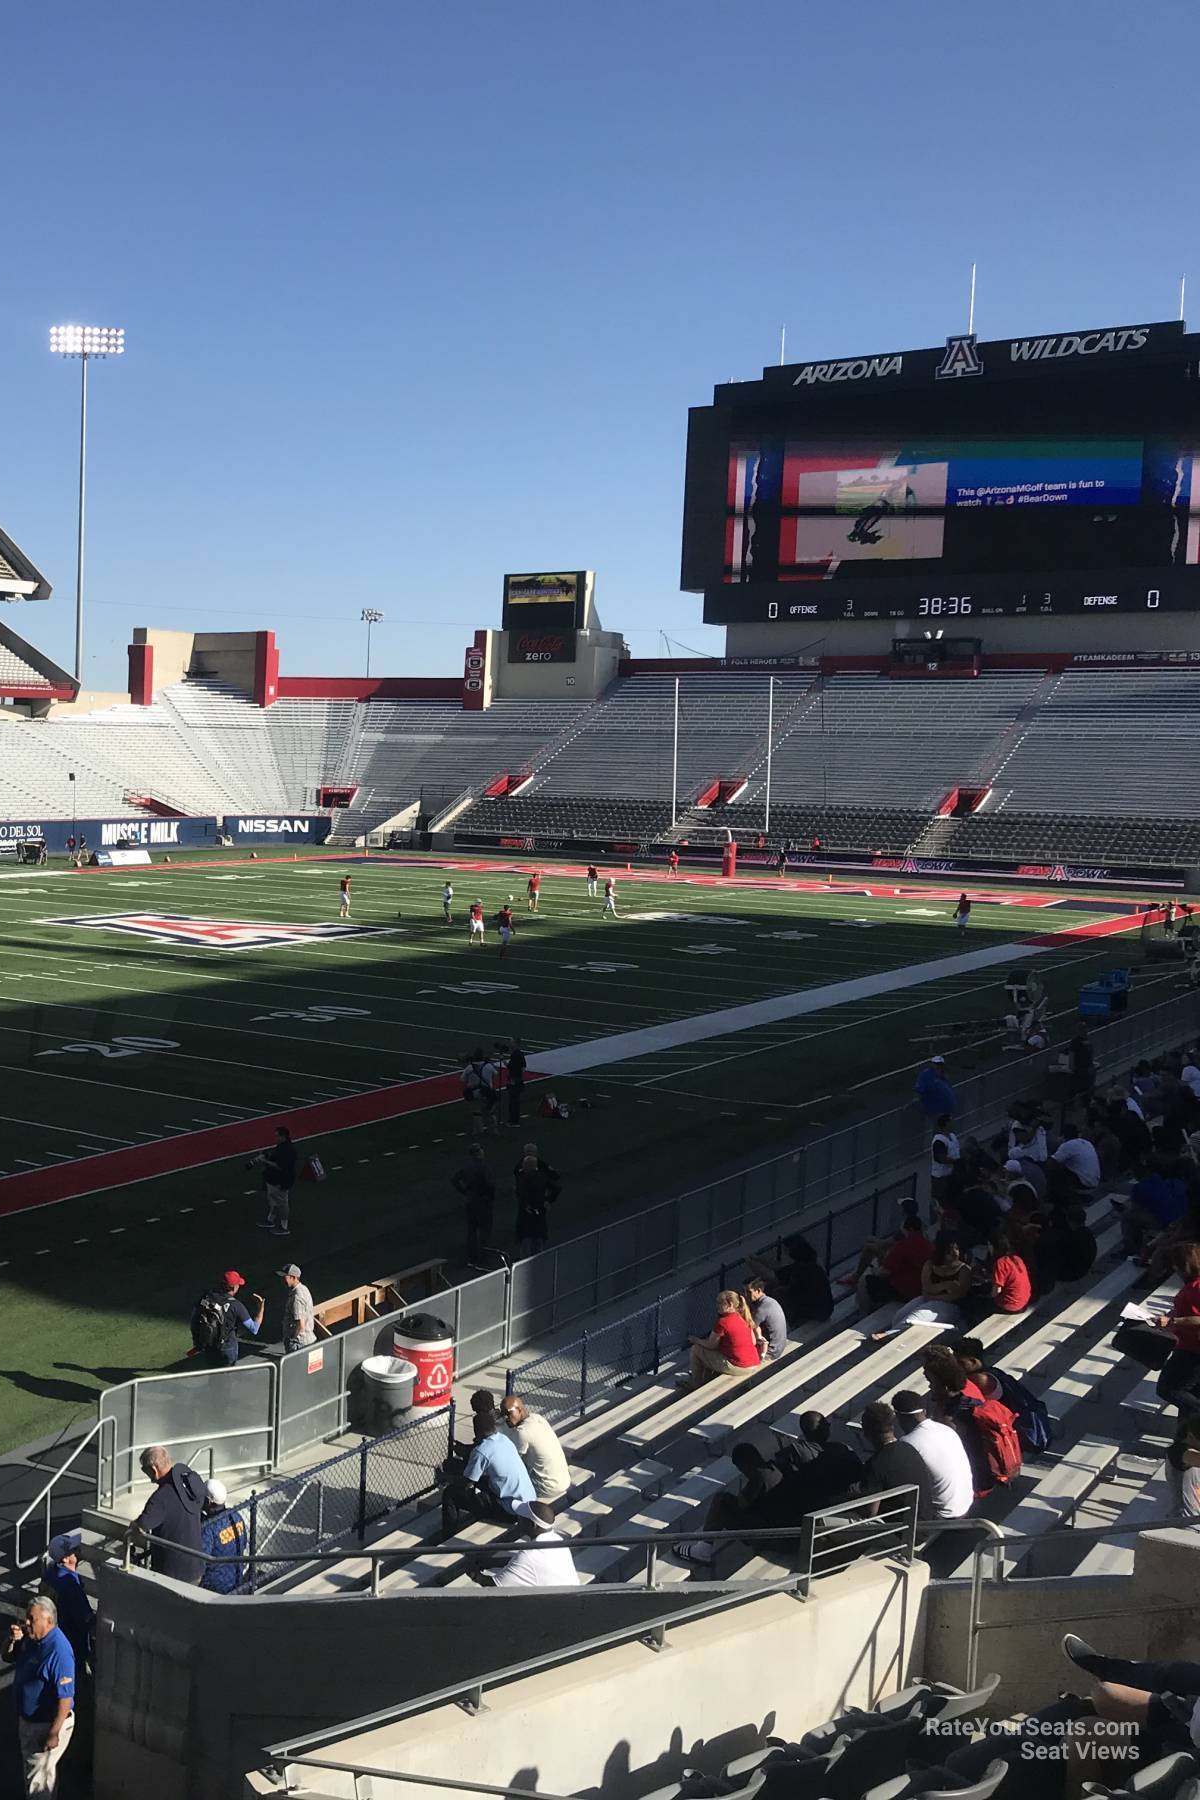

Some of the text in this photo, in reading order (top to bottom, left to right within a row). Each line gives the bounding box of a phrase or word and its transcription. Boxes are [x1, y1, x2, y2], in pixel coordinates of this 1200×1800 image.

[1010, 328, 1150, 362] WILDCATS
[793, 356, 902, 385] ARIZONA
[957, 480, 1104, 497] This @ArizonaMGolf team is fun to
[956, 494, 1068, 507] watch #BearDown
[919, 597, 972, 615] 38:36
[1084, 596, 1118, 606] DEFENSE
[790, 604, 817, 614] OFFENSE
[526, 652, 551, 661] zero
[928, 663, 937, 671] 12
[9, 826, 26, 838] DEL
[27, 825, 43, 837] SOL
[151, 822, 179, 843] MILK
[238, 820, 309, 832] NISSAN
[271, 1004, 372, 1023] 30
[61, 1036, 182, 1058] 20
